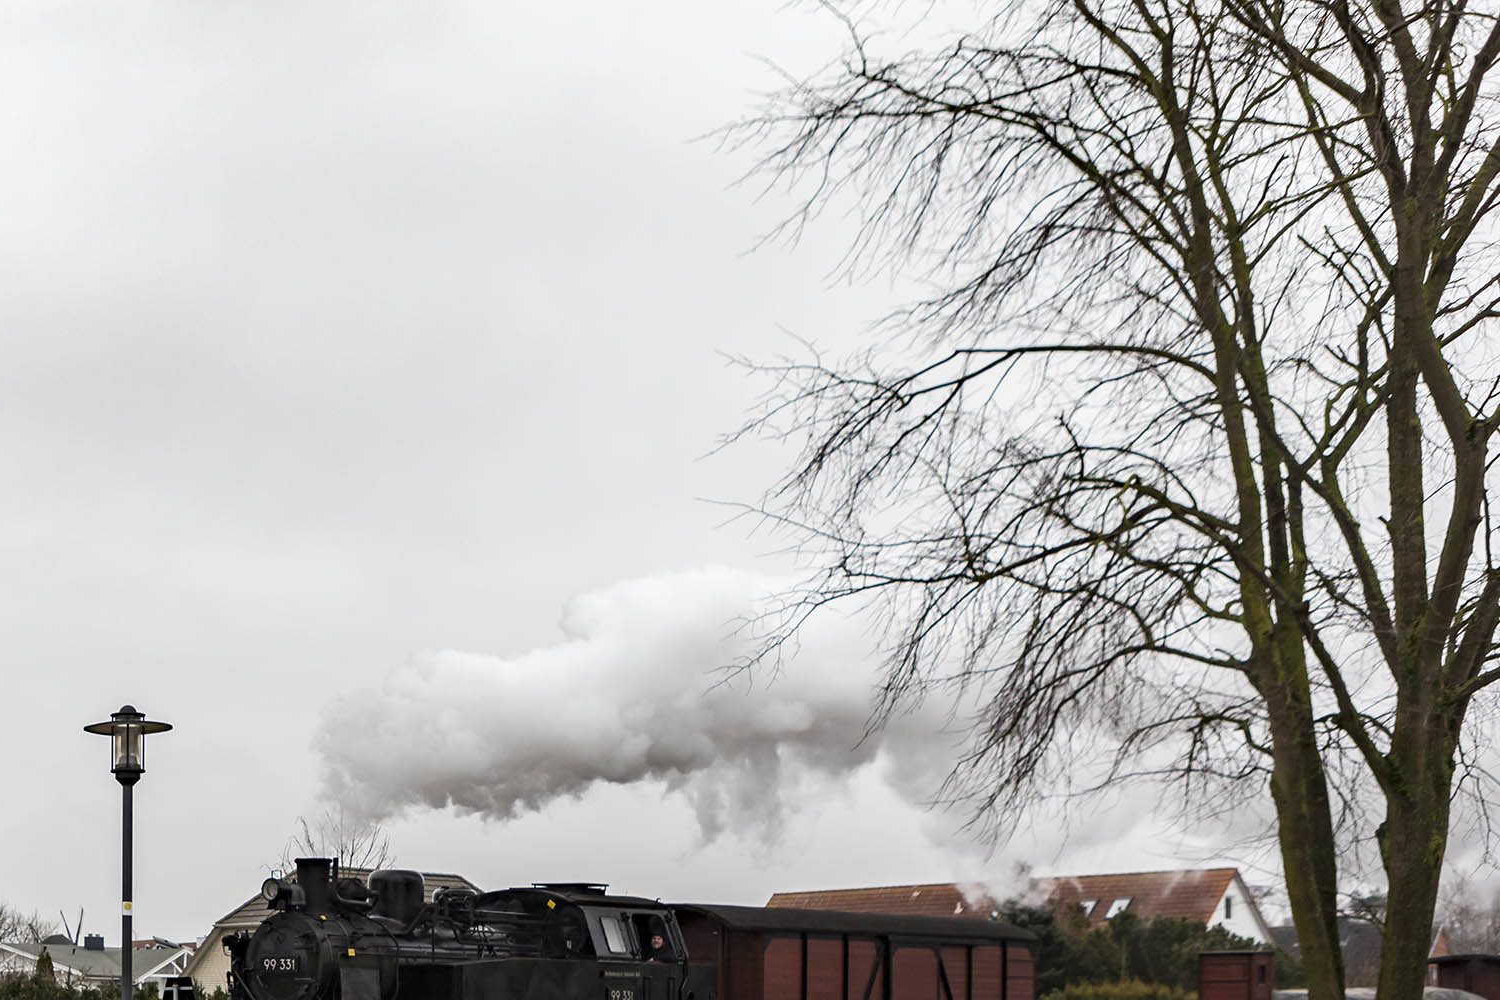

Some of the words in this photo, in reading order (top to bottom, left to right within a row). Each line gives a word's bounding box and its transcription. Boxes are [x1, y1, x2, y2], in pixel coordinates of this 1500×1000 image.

[263, 958, 277, 971] 99
[279, 958, 296, 971] 331
[611, 990, 620, 1000] 99
[622, 990, 634, 1000] 331
